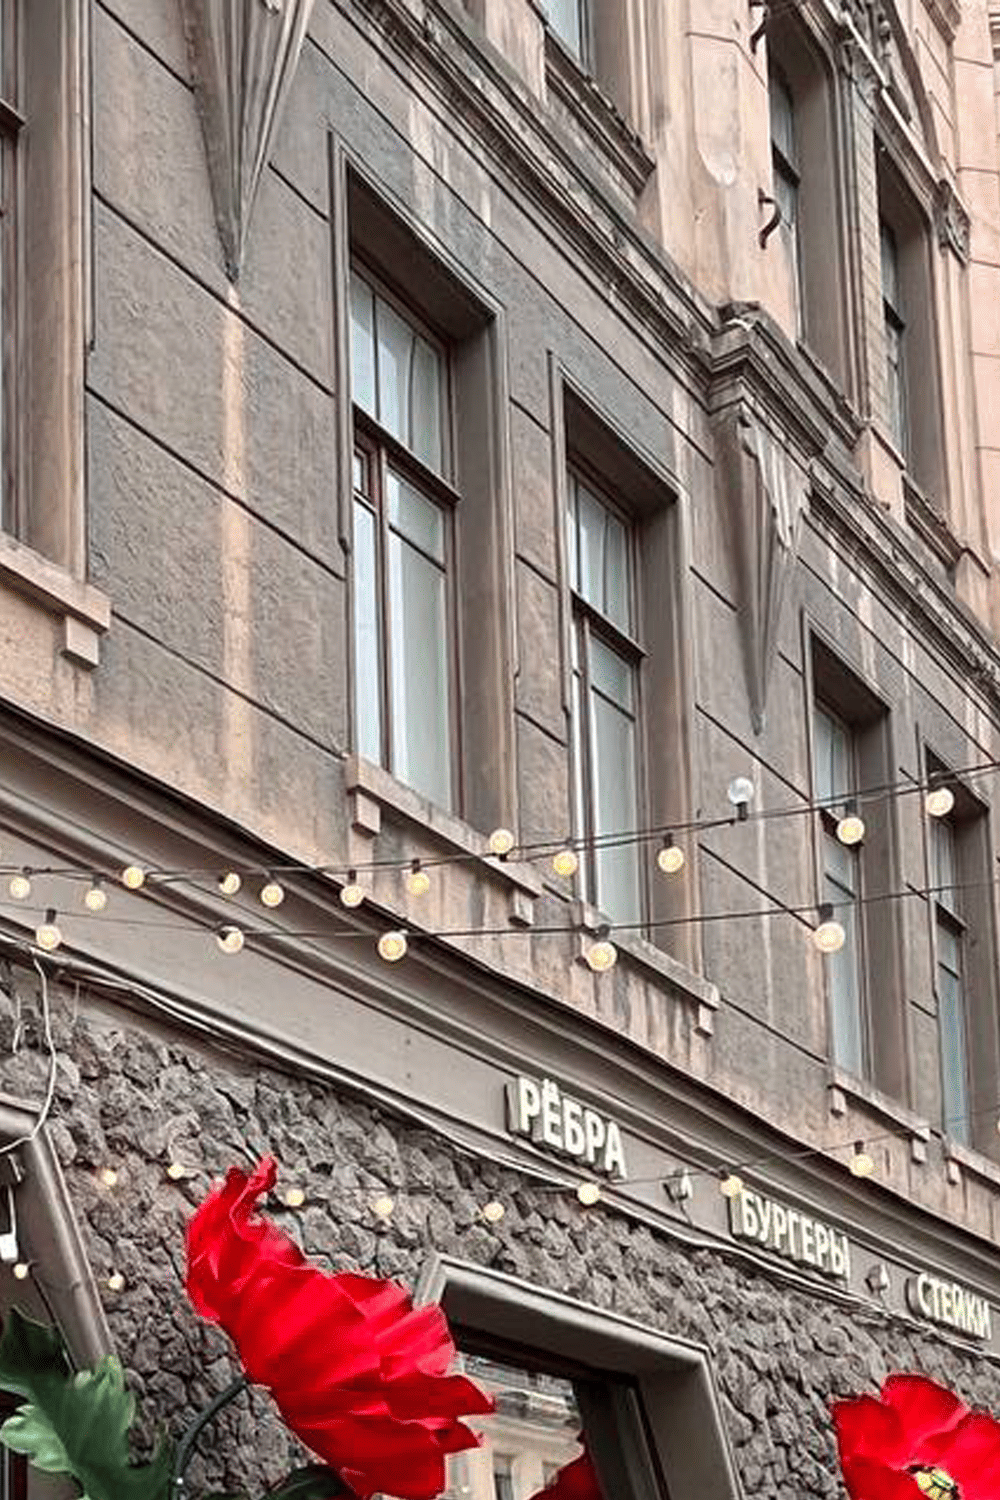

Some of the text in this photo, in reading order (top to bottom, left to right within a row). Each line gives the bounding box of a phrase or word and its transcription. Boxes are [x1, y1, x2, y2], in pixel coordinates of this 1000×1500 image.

[517, 1077, 627, 1180] РЁБРА
[740, 1191, 851, 1284] БУРГЕРЫ
[917, 1272, 992, 1340] СТЕЙКИ
